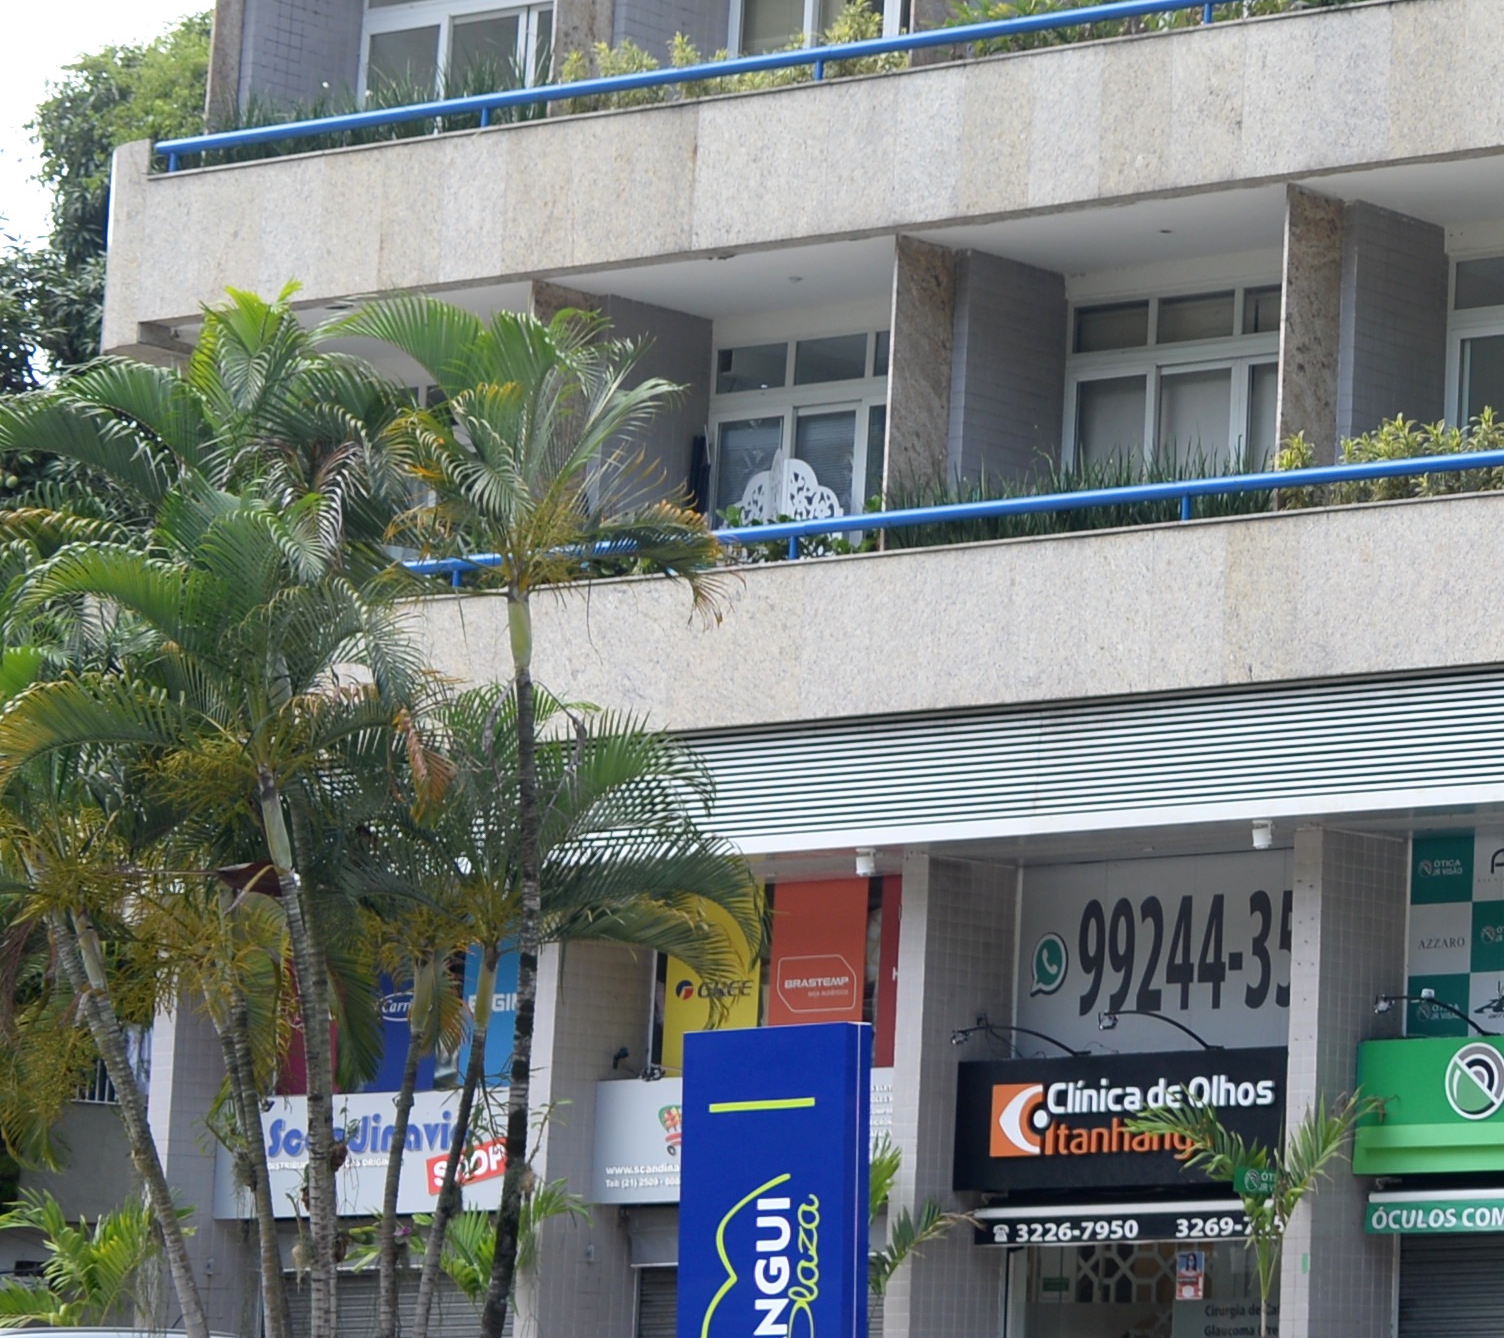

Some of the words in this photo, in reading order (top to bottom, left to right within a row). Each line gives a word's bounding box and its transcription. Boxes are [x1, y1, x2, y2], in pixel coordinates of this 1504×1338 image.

[1418, 938, 1465, 950] AZZARO
[784, 976, 849, 990] BRASTEMP
[1046, 1077, 1143, 1114] Clínica
[1147, 1077, 1184, 1109] de
[1187, 1074, 1276, 1108] Olhos
[1371, 1206, 1457, 1231] ÓCULOS
[1015, 1218, 1140, 1243] 3226-7950
[1204, 1303, 1246, 1320] Cirurgia
[1204, 1324, 1255, 1338] Glaucoma
